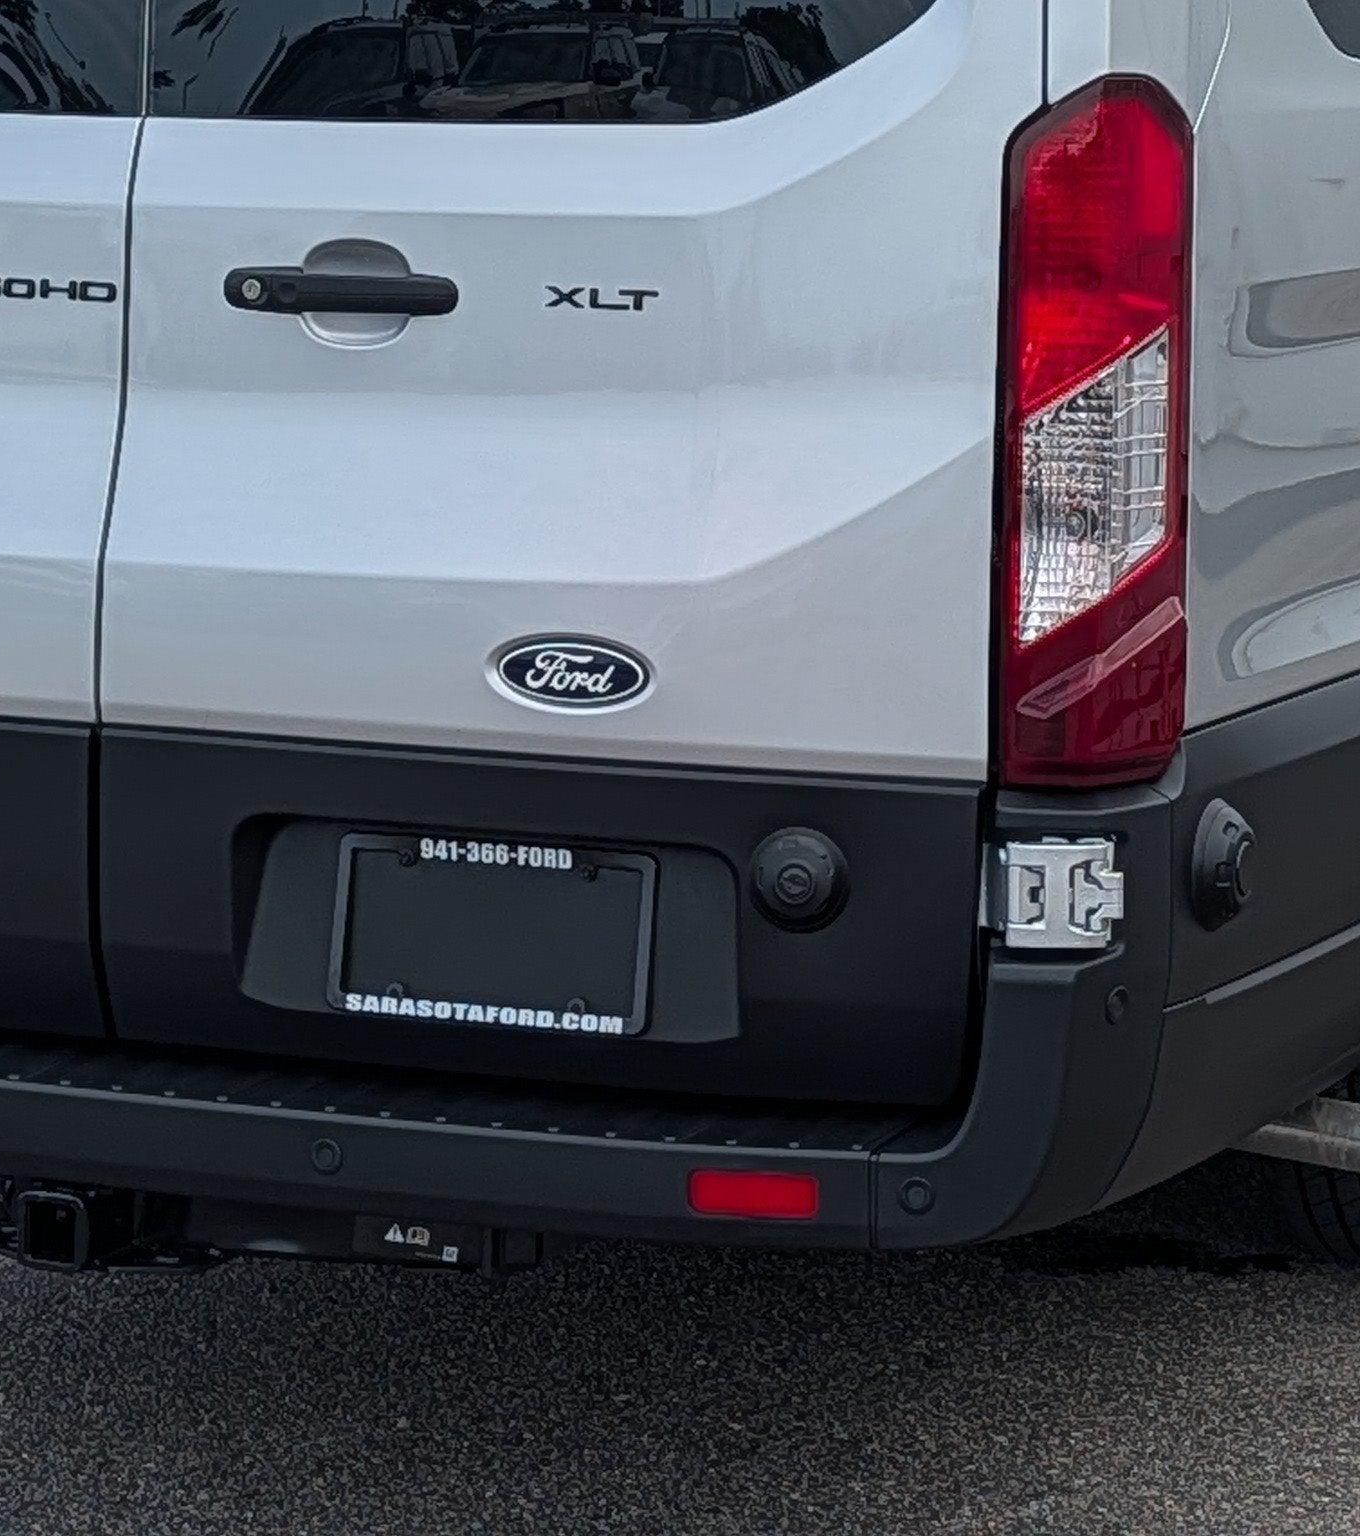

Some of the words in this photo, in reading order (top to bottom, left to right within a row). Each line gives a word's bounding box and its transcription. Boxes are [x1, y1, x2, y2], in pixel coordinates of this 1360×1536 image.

[544, 284, 660, 312] XLT
[524, 649, 616, 694] Ford
[419, 837, 573, 871] 941-366-FORD
[344, 992, 624, 1036] SARASOTAFORD.COM
